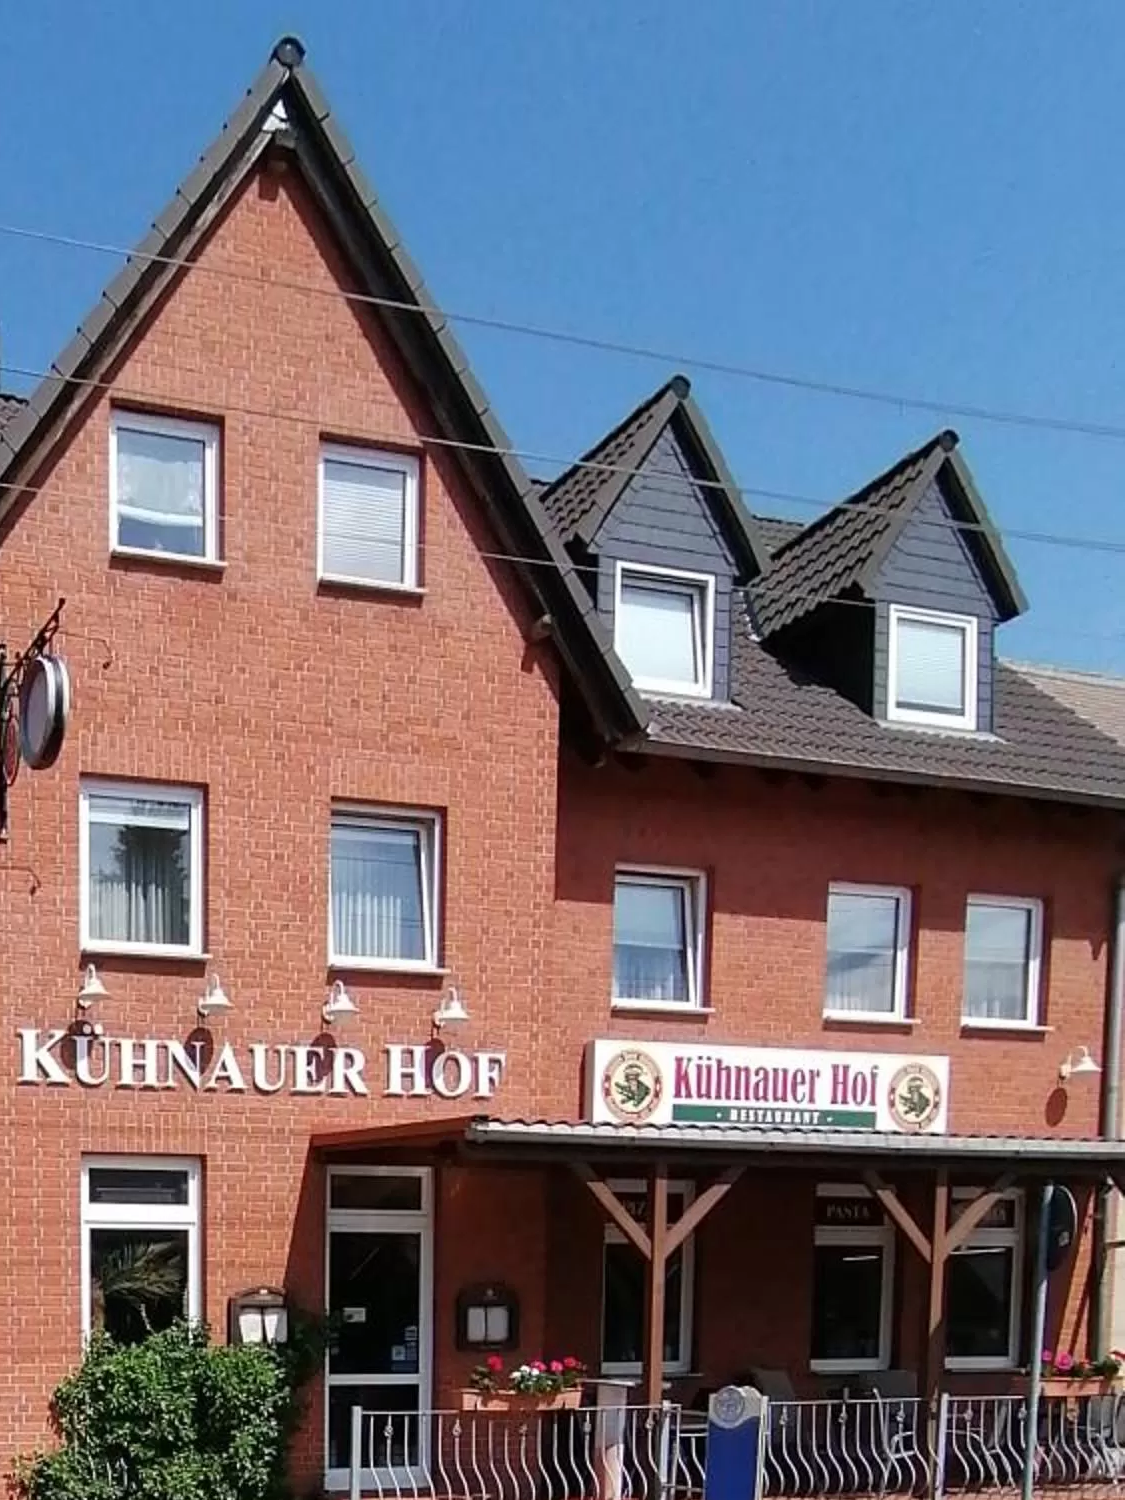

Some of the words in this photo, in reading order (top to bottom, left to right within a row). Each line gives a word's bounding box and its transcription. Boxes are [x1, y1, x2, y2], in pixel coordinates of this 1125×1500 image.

[17, 1023, 368, 1096] KÜHNAUER
[384, 1043, 507, 1099] HOF
[672, 1055, 822, 1106] Kühnauer
[830, 1063, 878, 1107] Hof
[728, 1108, 821, 1125] RESTAURANT
[826, 1203, 871, 1219] PASTA
